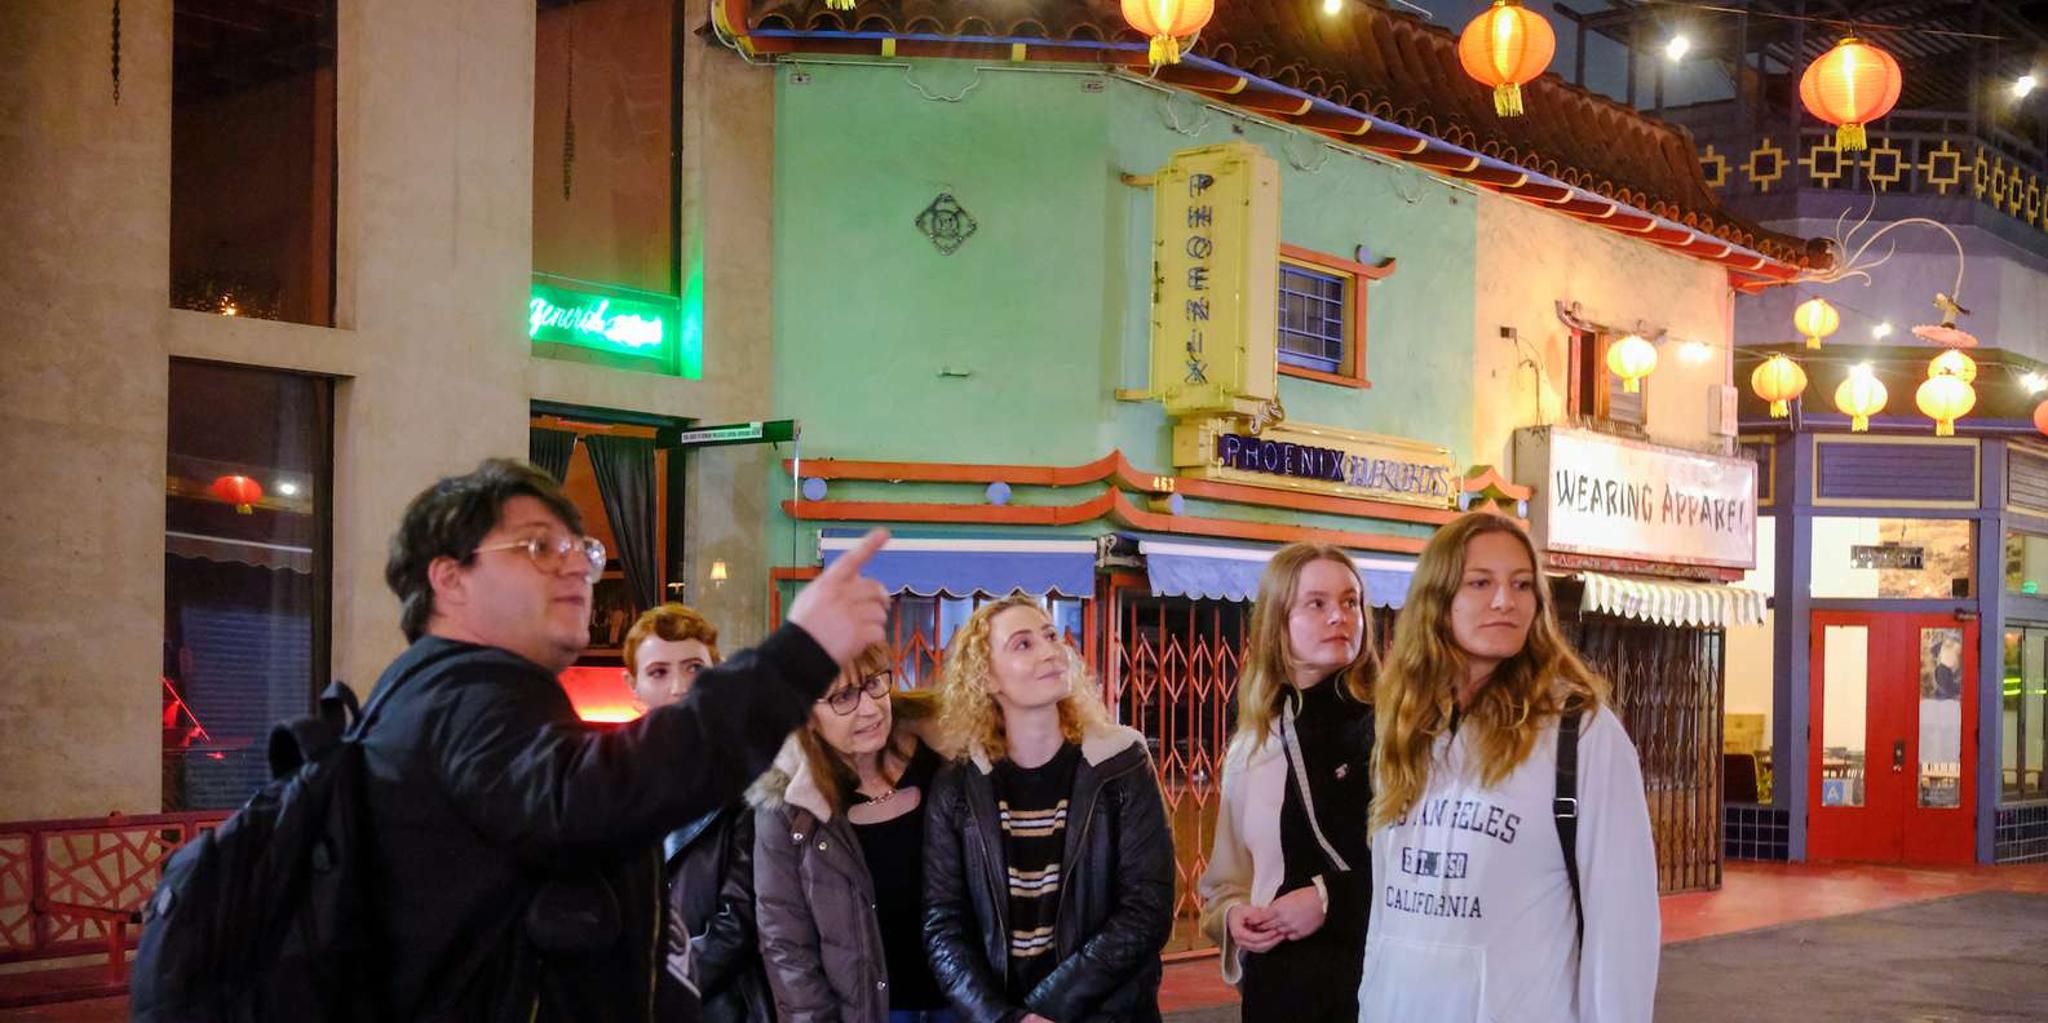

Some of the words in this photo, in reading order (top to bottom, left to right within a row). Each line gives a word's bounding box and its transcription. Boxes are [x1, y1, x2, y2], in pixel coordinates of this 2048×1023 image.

[1184, 173, 1214, 384] PHOENIX
[1226, 437, 1343, 480] PHOENIX
[1556, 469, 1652, 523] WEARING
